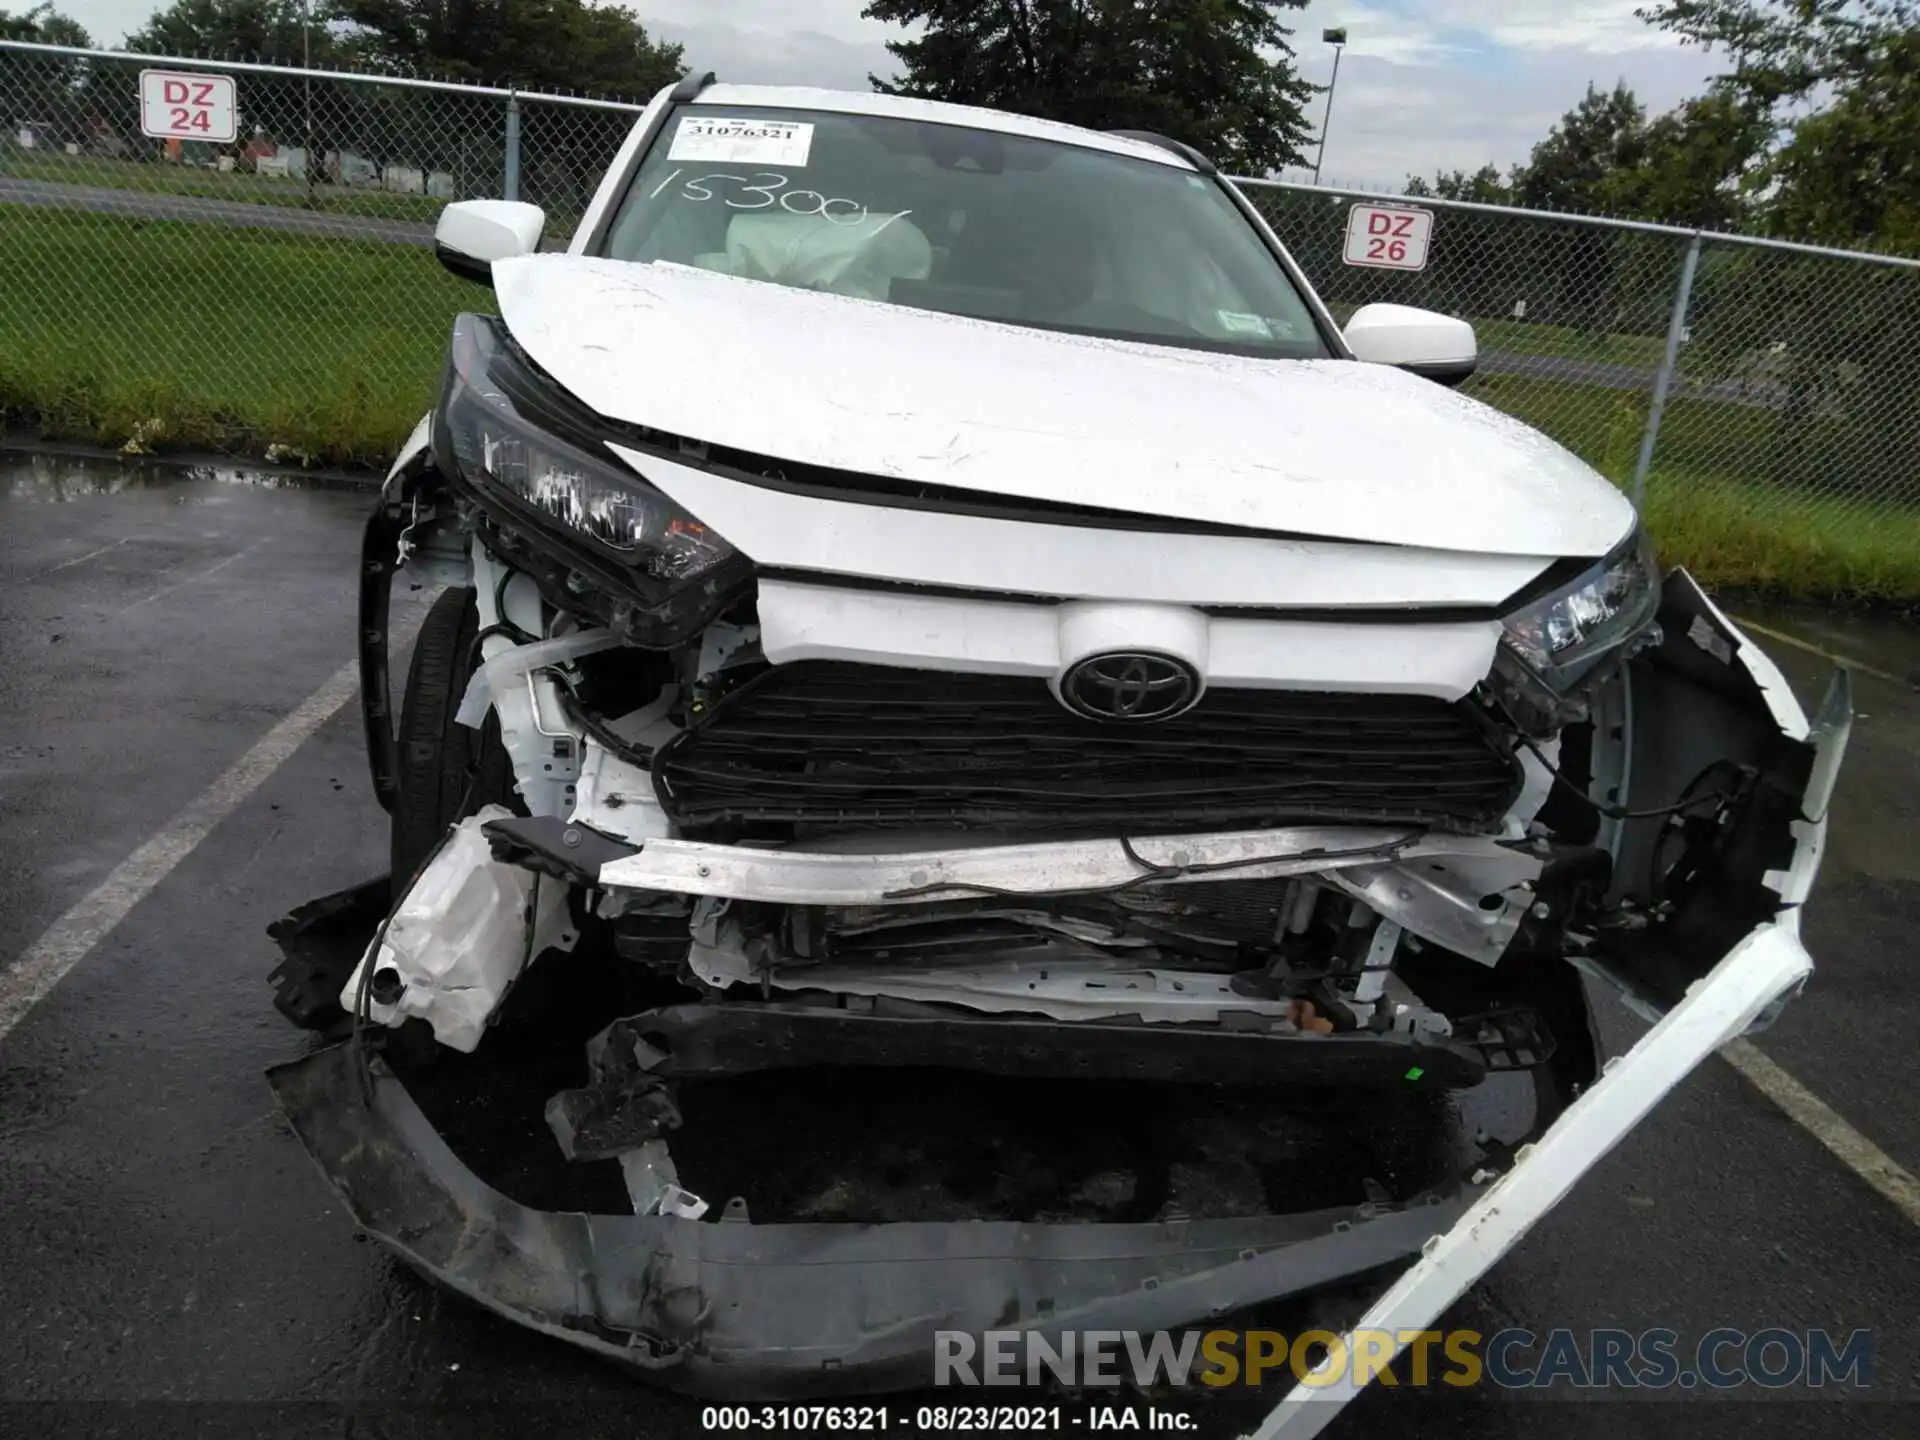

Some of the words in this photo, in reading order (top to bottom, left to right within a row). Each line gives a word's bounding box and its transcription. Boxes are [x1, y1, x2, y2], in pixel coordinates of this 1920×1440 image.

[164, 80, 215, 107] DZ
[170, 108, 211, 132] 24
[688, 125, 794, 140] 31076321
[1368, 213, 1415, 238] DZ
[1366, 238, 1406, 261] 26
